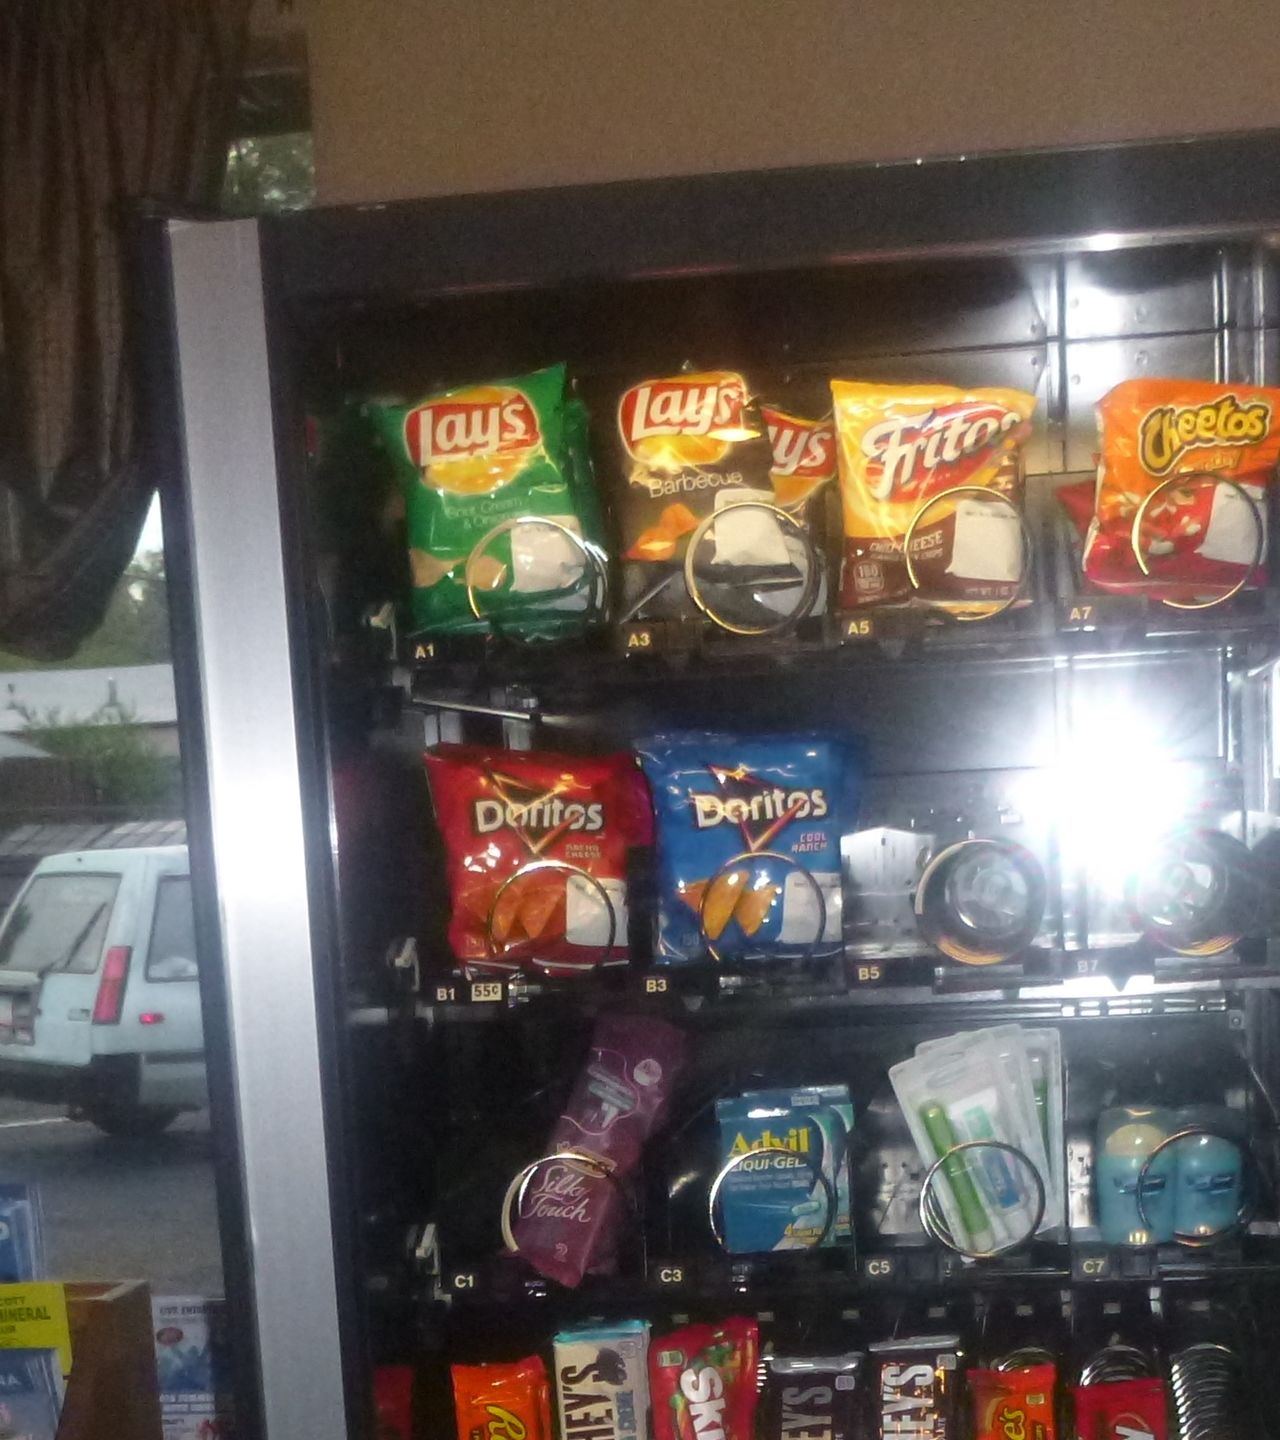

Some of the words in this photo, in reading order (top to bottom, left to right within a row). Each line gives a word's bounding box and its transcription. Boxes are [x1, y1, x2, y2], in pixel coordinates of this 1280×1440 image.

[631, 377, 744, 442] Lay's
[418, 400, 527, 462] Lay's
[1143, 398, 1268, 474] Cheetos
[768, 426, 832, 475] y's
[649, 470, 744, 498] Barbecue
[1069, 606, 1092, 622] A7
[847, 621, 870, 636] A5
[628, 632, 651, 648] A3
[414, 645, 434, 660] A1
[475, 799, 604, 833] Doritos
[693, 787, 828, 829] Doritos
[858, 966, 881, 981] B5
[1077, 959, 1099, 974] B7
[646, 978, 668, 993] B3
[436, 988, 456, 1001] B1
[728, 1127, 811, 1158] Advil
[533, 1165, 590, 1201] Silky
[524, 1194, 592, 1224] Touch
[868, 1261, 890, 1275] C5
[1082, 1260, 1105, 1274] C7
[455, 1275, 474, 1289] C1
[660, 1268, 682, 1283] C3
